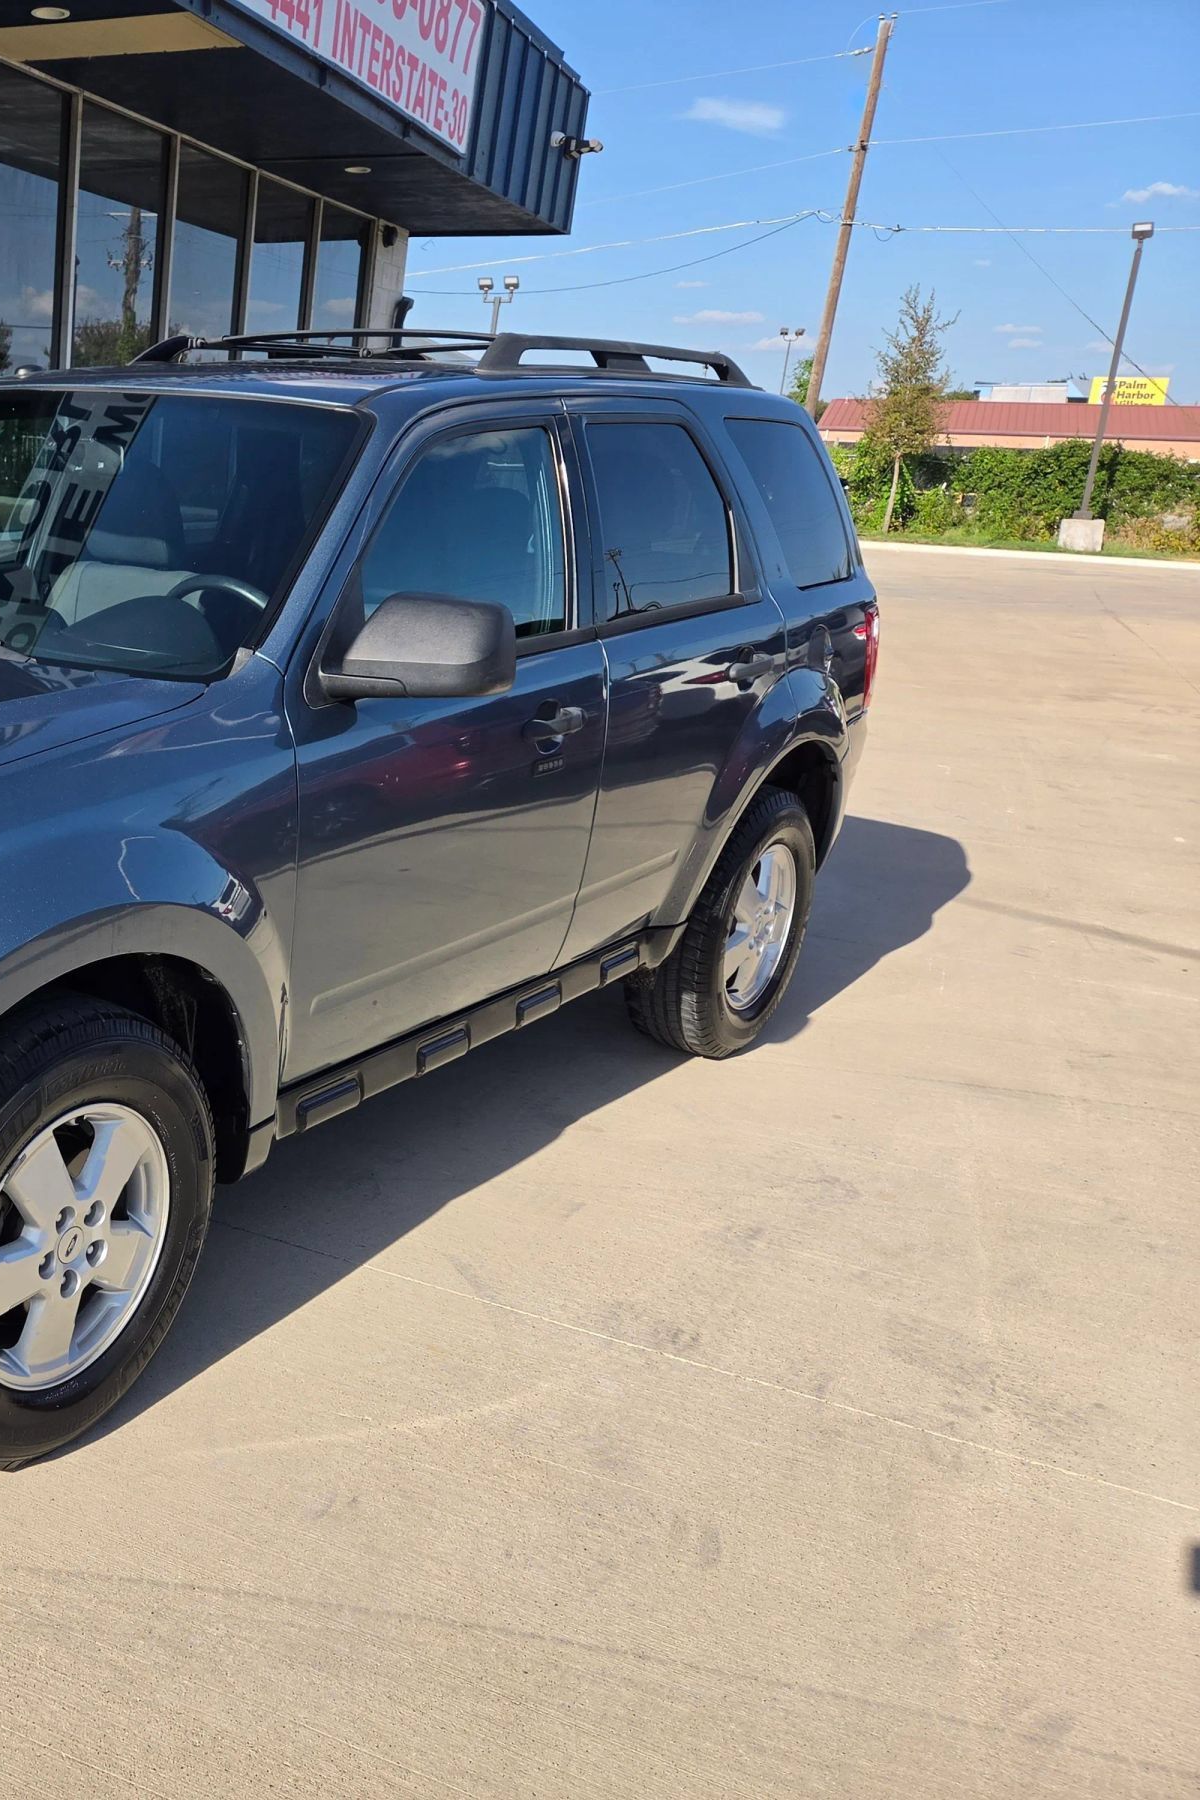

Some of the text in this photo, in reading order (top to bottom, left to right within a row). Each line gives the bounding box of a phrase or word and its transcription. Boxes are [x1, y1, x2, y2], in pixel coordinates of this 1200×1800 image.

[331, 0, 468, 146] INTERSTATE-30
[1117, 380, 1147, 390] Palm
[1116, 390, 1156, 400] Harbor
